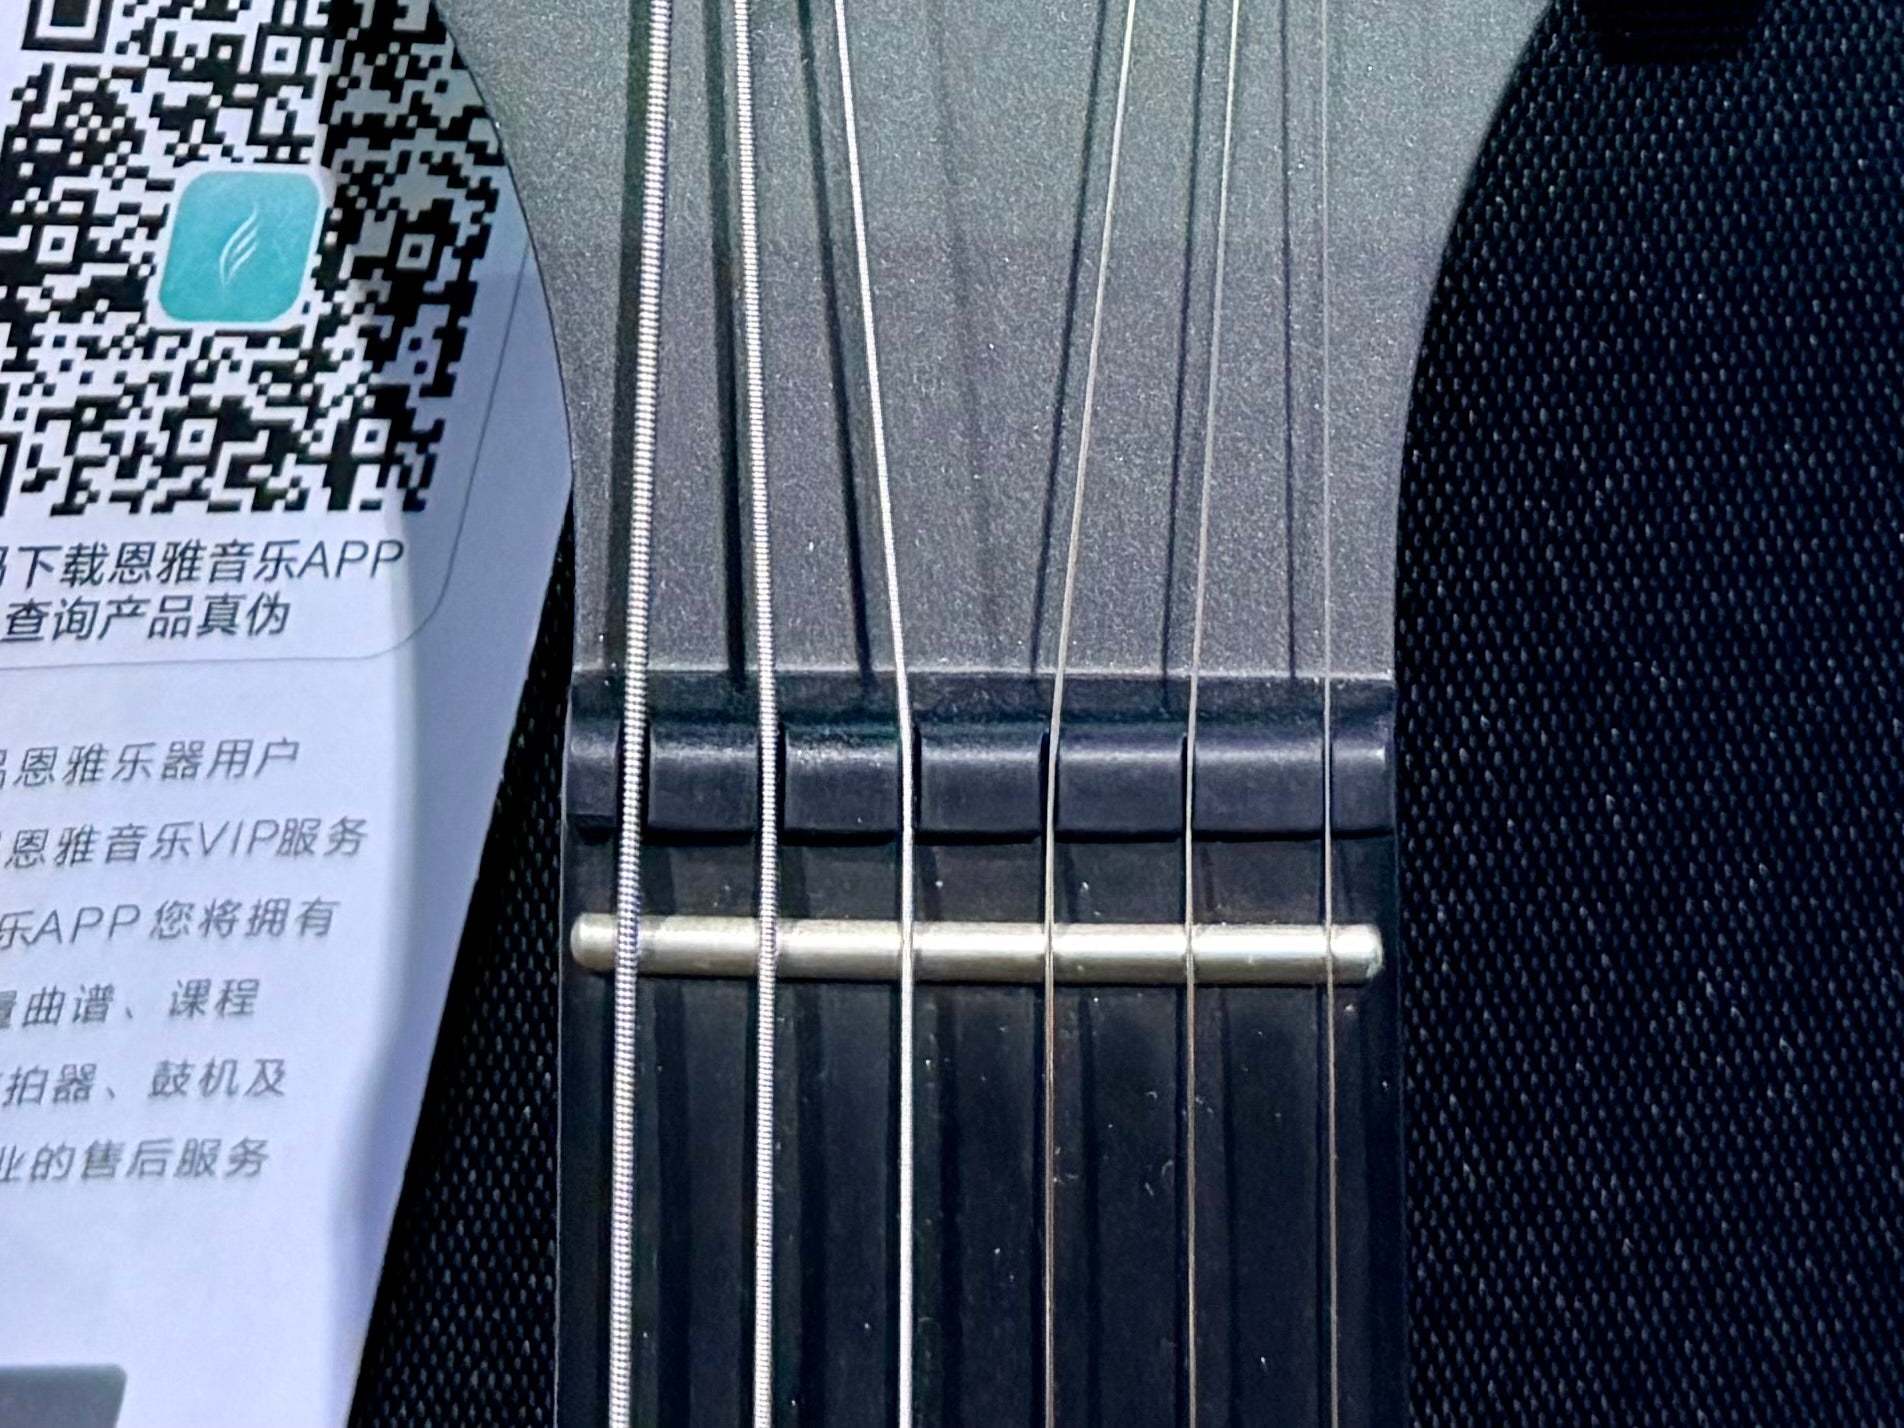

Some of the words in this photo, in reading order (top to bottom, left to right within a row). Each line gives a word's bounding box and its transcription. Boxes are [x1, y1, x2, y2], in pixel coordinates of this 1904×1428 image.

[0, 591, 292, 645] 查询产品真伪
